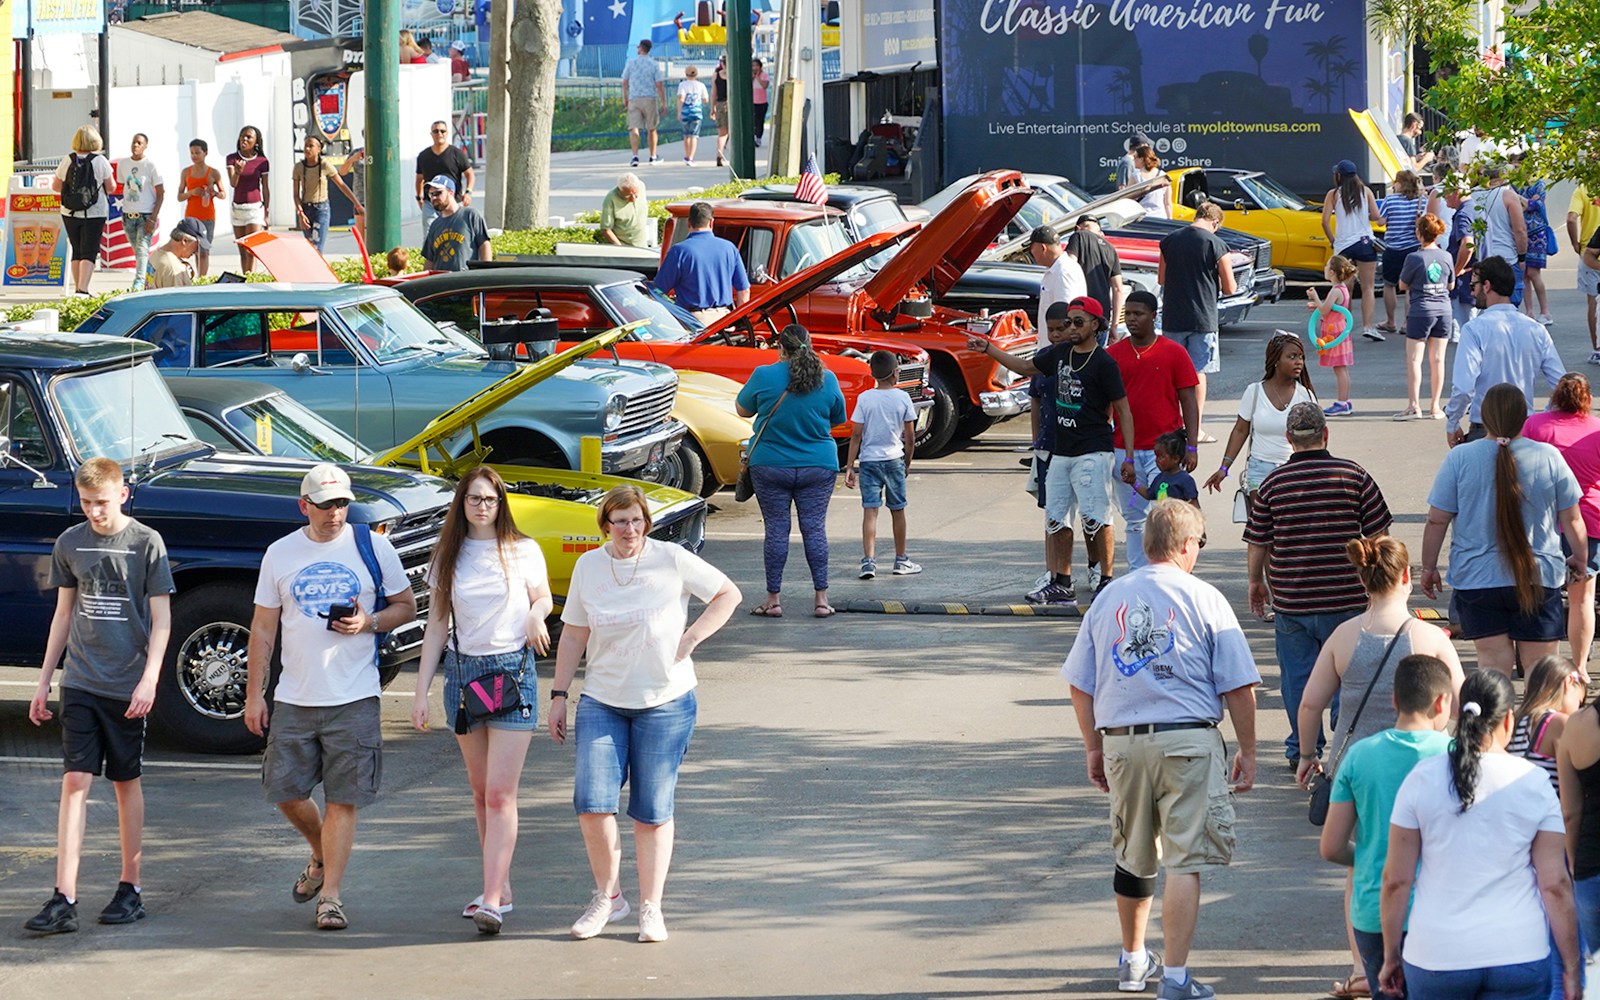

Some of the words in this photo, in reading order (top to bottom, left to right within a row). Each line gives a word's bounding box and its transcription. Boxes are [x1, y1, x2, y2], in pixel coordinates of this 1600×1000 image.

[980, 0, 1100, 35] Classic
[1109, 0, 1256, 31] American
[1264, 0, 1325, 30] Fun
[989, 122, 1015, 135] Live
[1017, 122, 1109, 134] Entertainment
[1112, 121, 1171, 134] Schedule
[1173, 122, 1186, 133] at
[1188, 121, 1321, 136] myoldtownusa.com
[1178, 156, 1212, 168] Share
